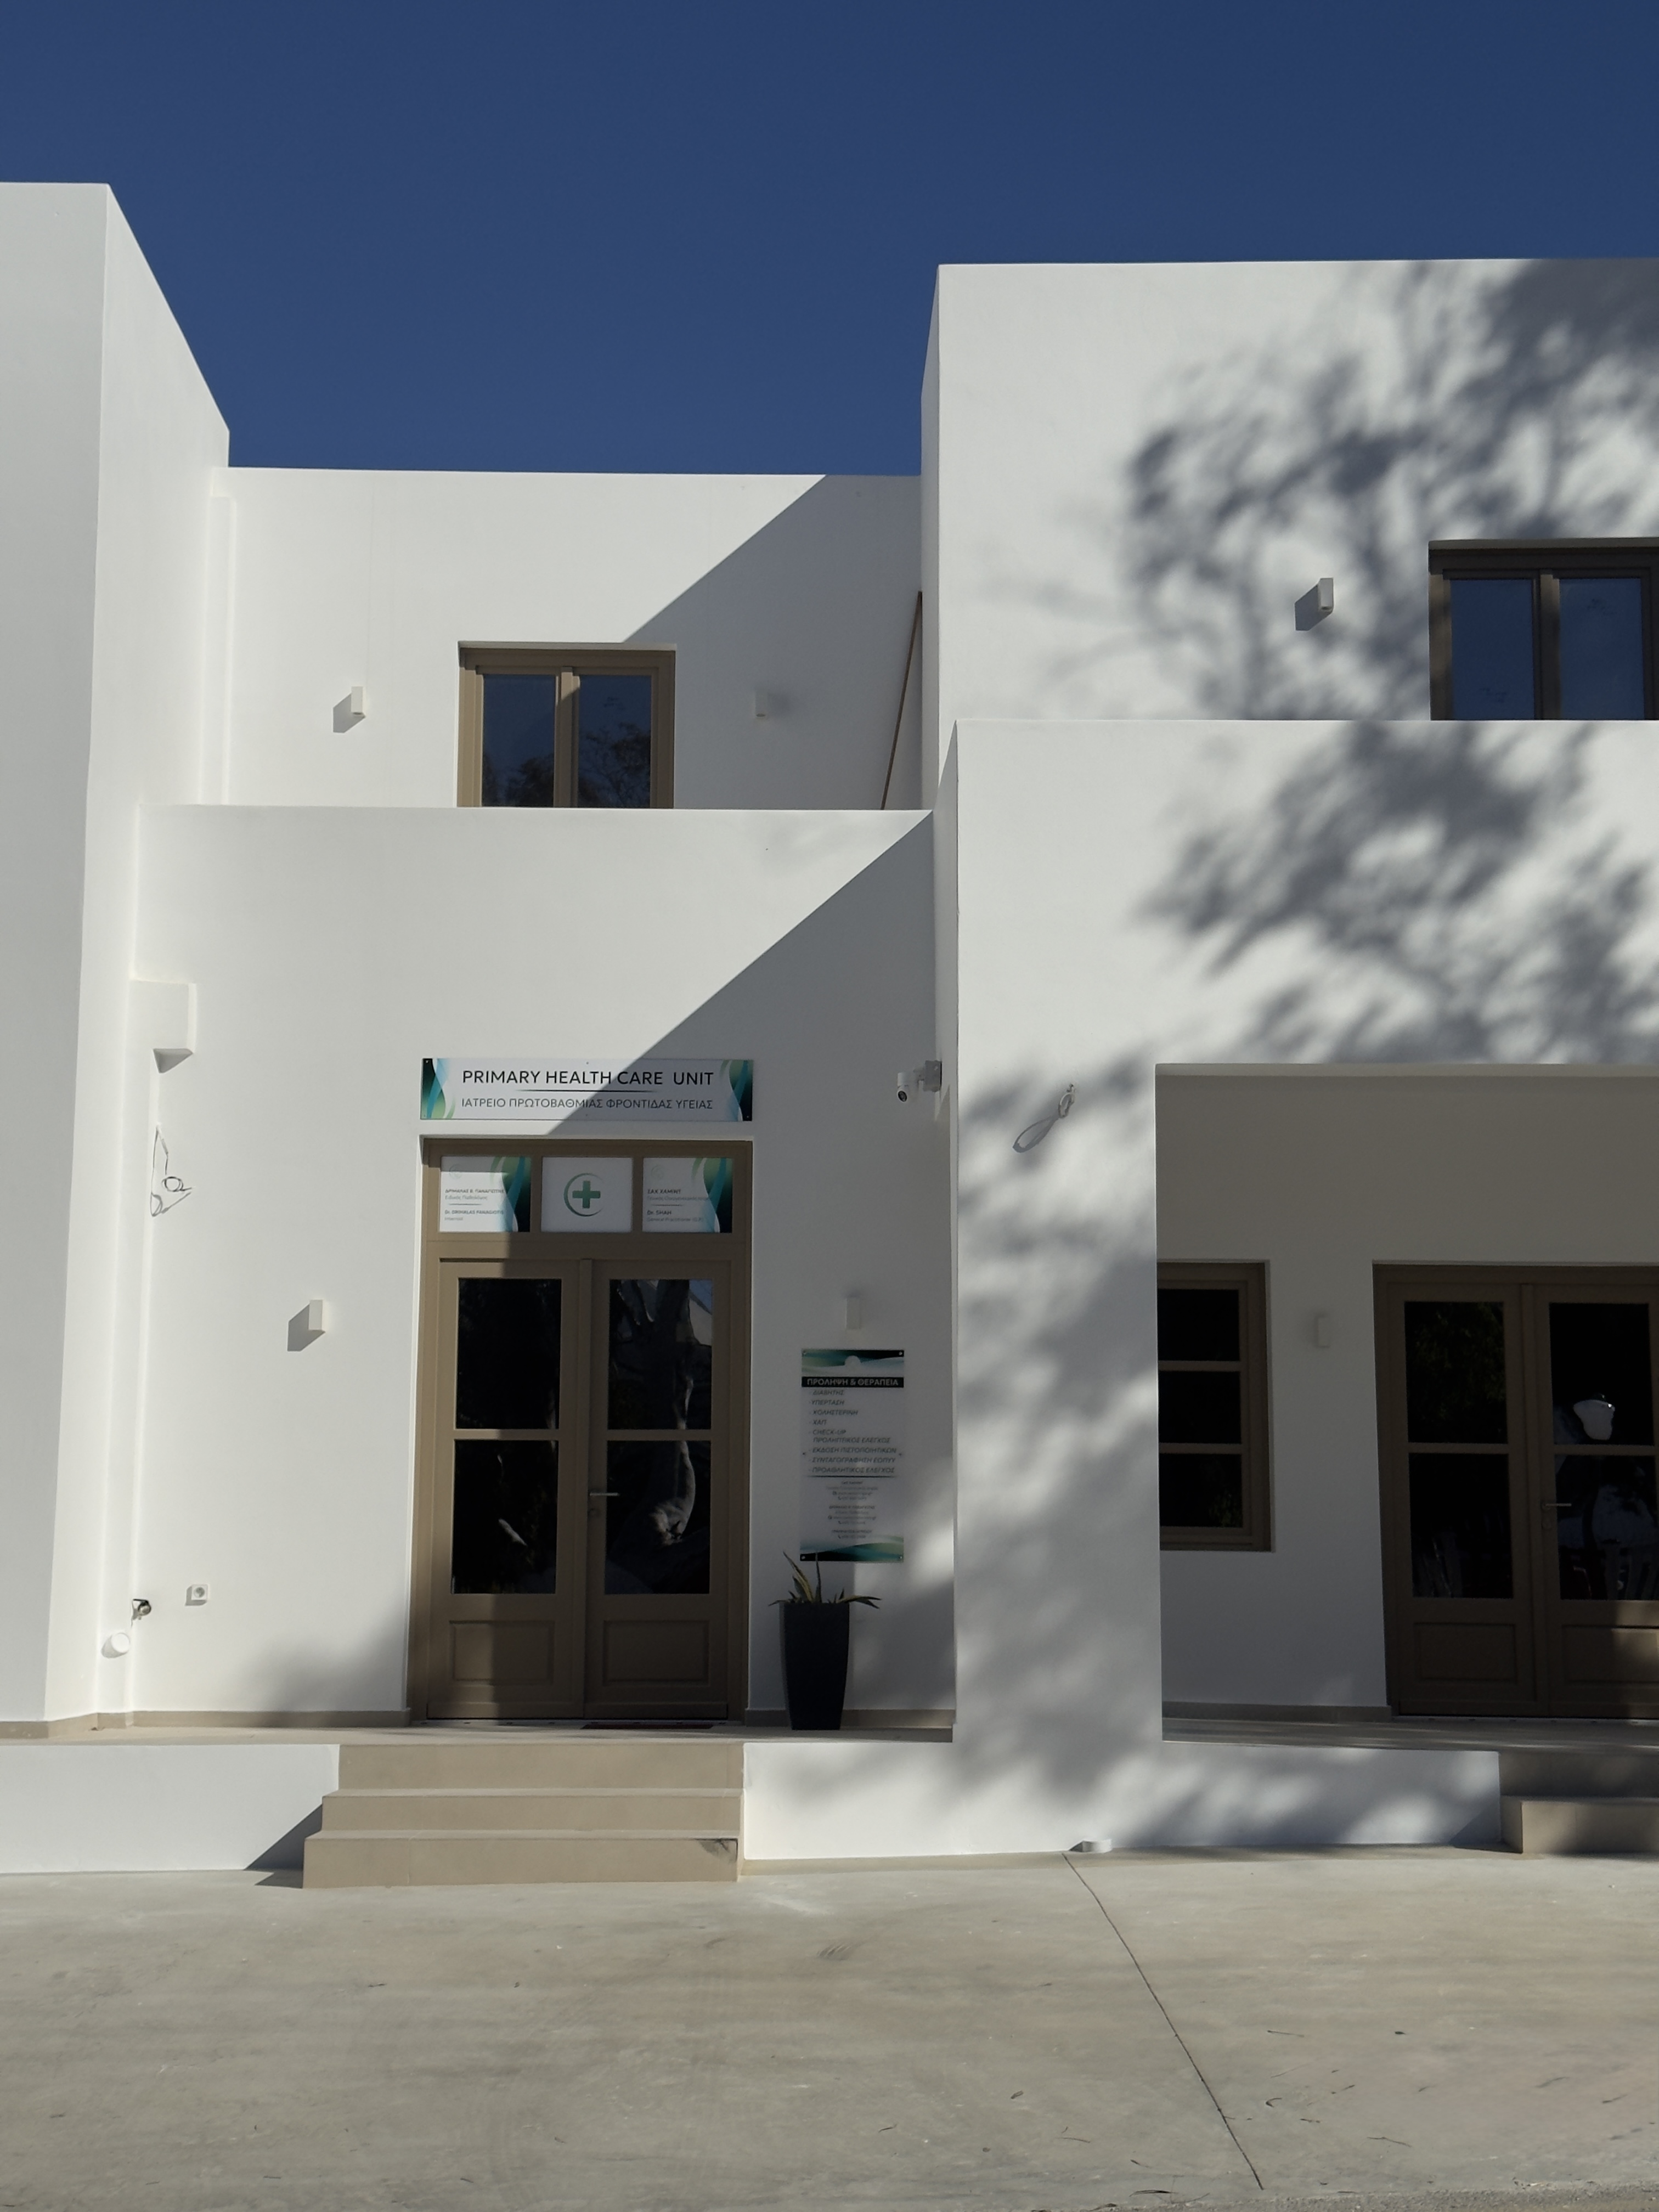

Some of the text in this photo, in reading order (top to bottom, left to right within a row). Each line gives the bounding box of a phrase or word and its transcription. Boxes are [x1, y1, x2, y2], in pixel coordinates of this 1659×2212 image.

[462, 1070, 714, 1086] PRIMARY HEALTH CARE UNIT
[462, 1098, 713, 1109] ΙΑΤΡΕΙΟ ΠΡΩΤΟΒΑΘΜΙΑΣ ΦΡΟΝΤΙΔΑΣ ΥΓΕΙΑΣ
